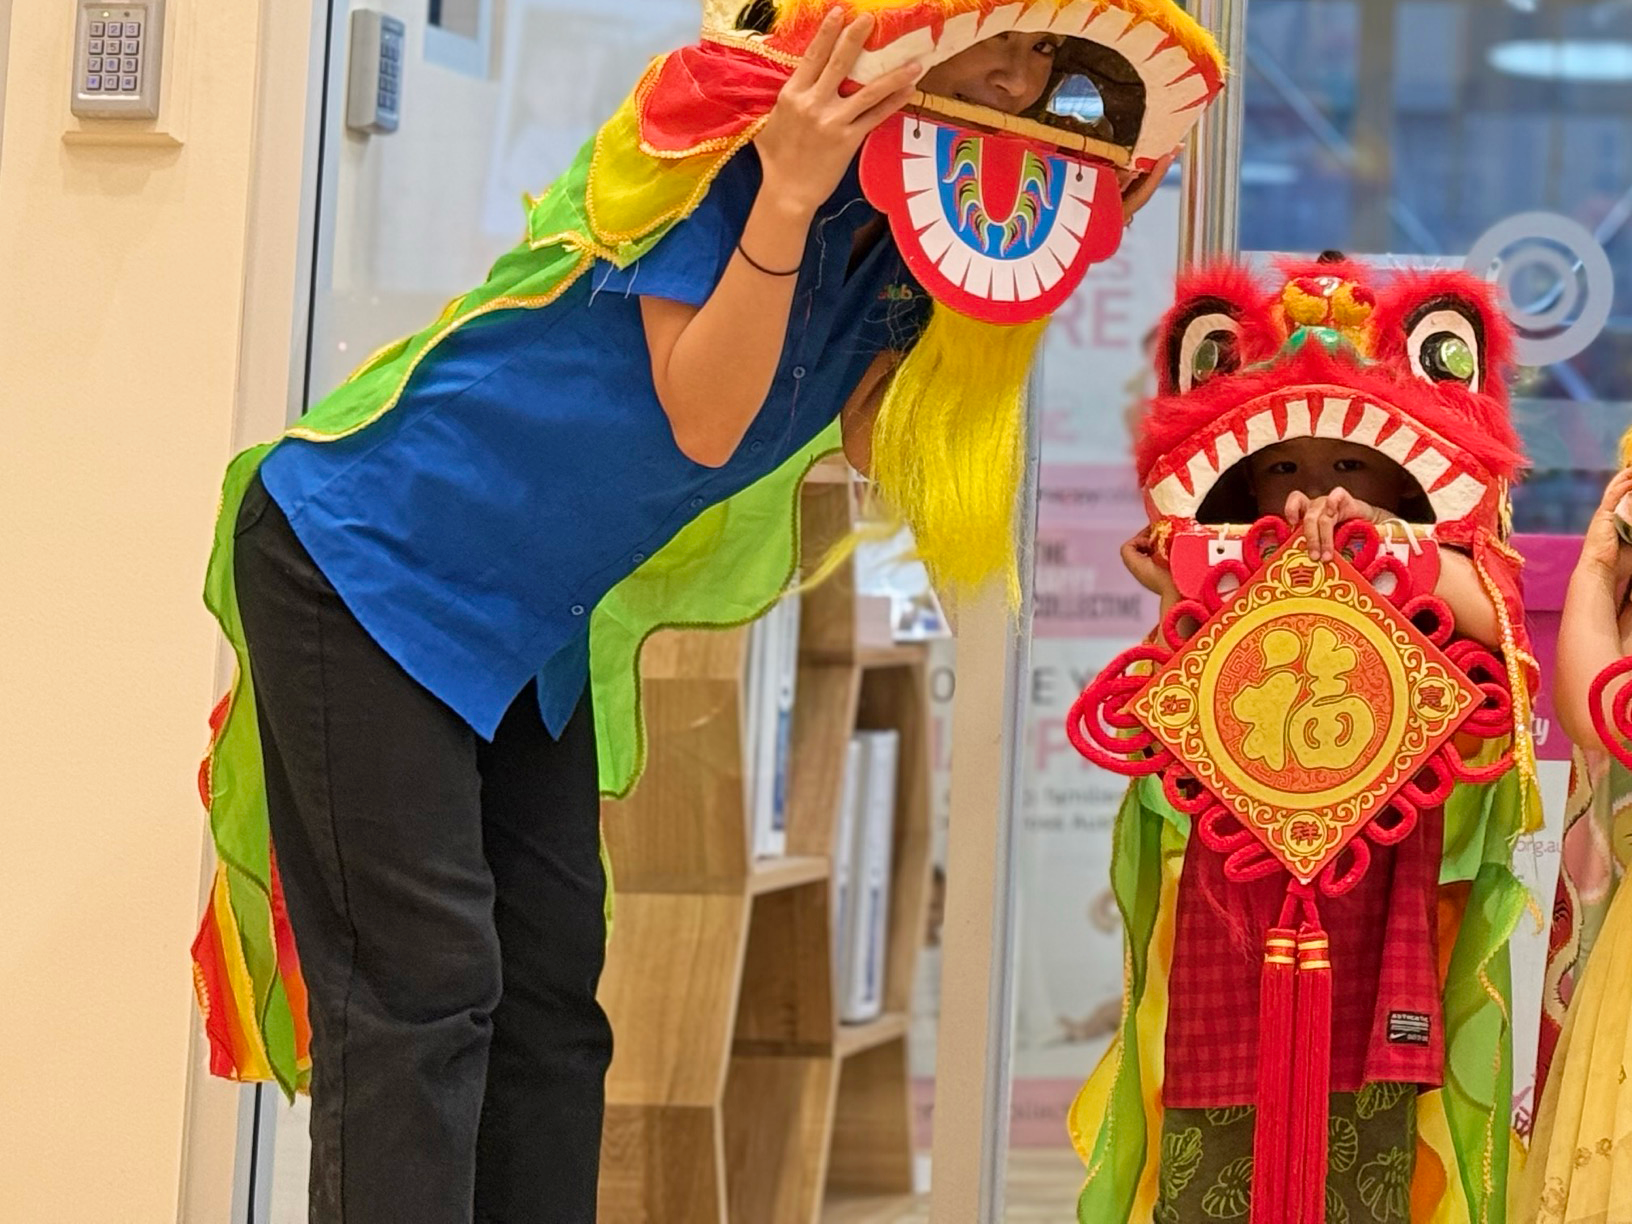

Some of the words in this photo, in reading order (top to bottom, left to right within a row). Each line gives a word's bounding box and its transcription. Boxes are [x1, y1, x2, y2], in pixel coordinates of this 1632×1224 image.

[1287, 563, 1316, 587] 吉
[1160, 694, 1191, 717] 如
[1231, 625, 1375, 771] 福
[1290, 820, 1323, 846] 祥
